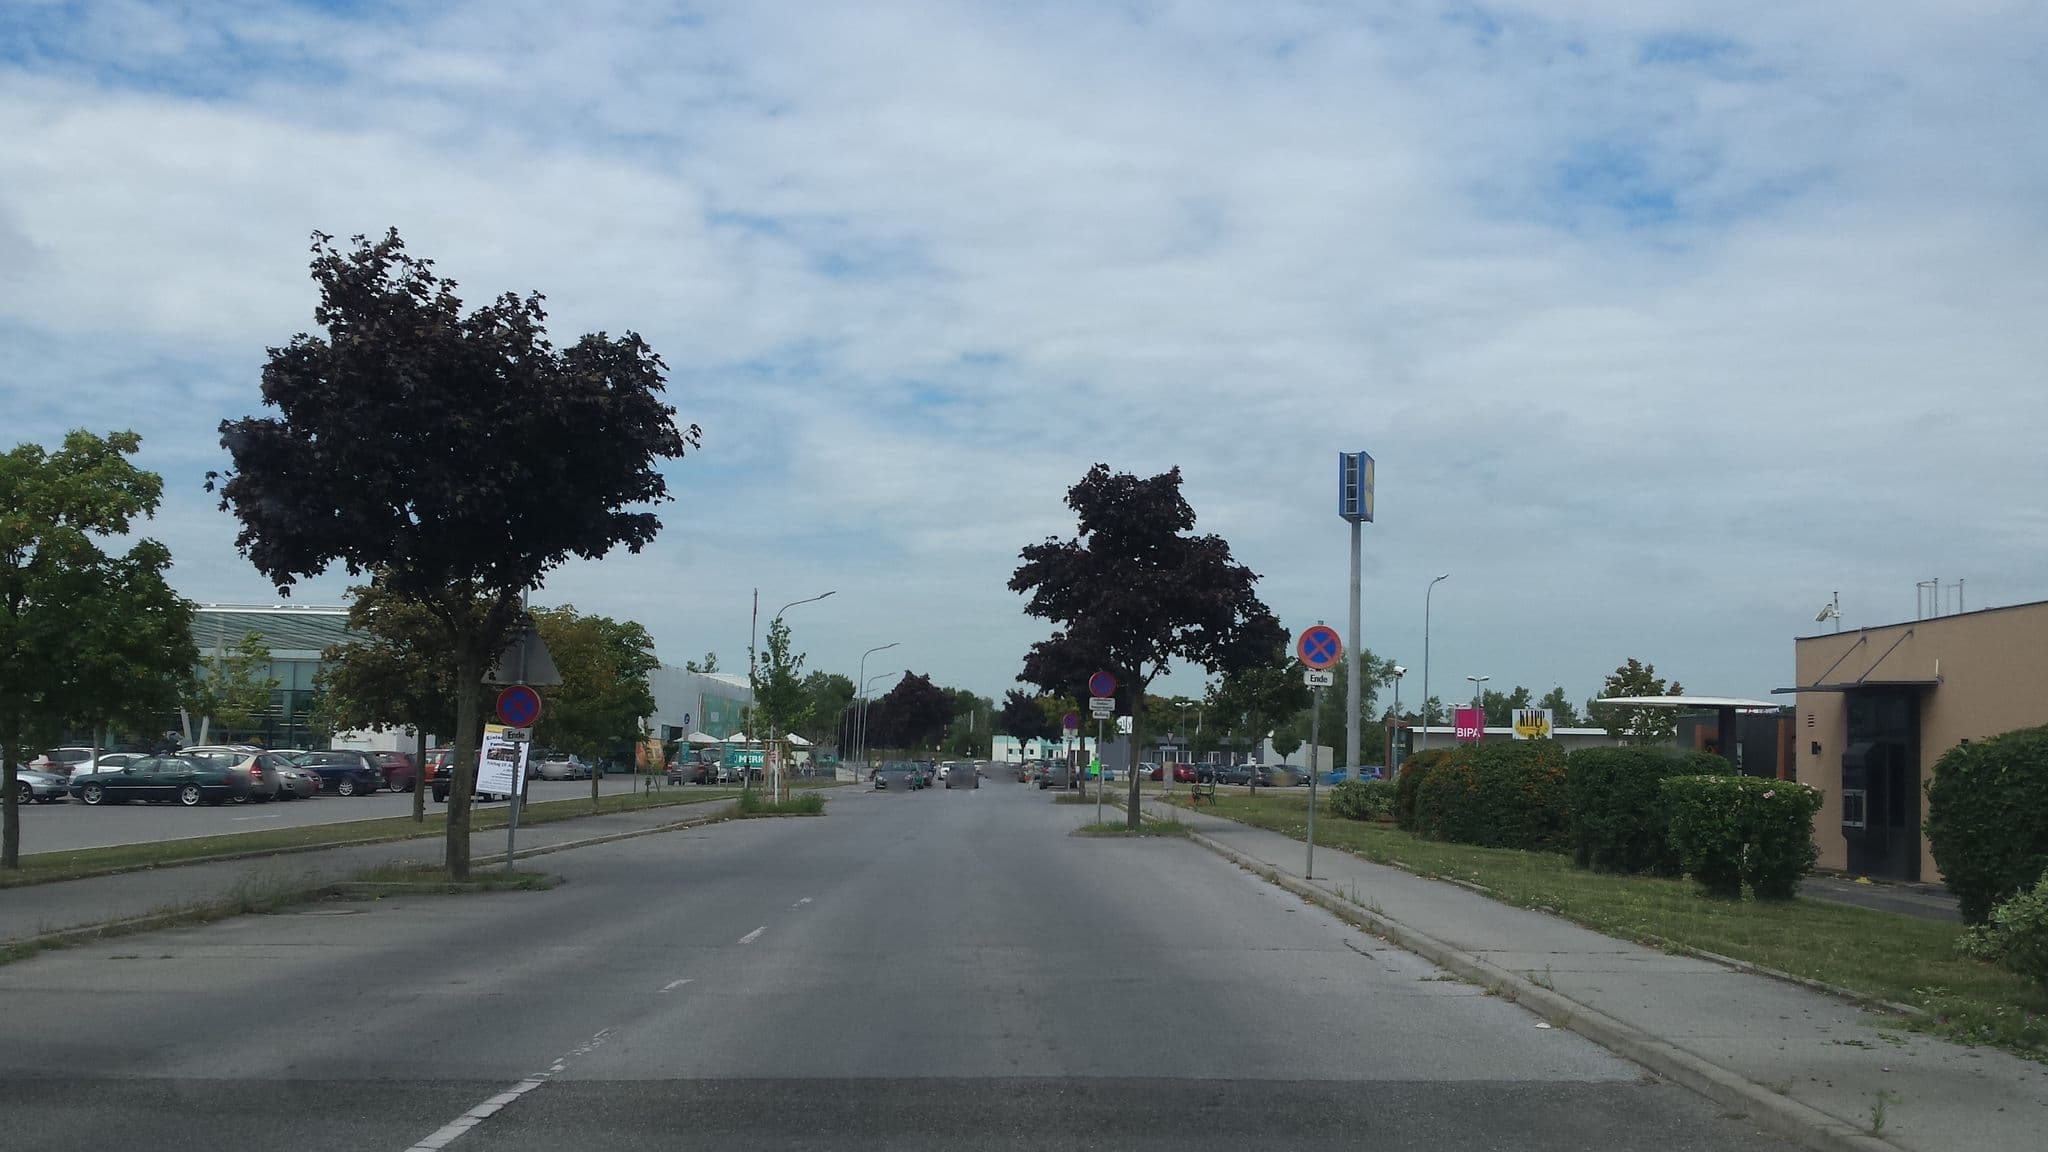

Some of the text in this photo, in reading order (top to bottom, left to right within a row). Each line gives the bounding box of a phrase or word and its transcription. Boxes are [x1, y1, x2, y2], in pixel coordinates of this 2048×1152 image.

[1310, 675, 1328, 683] Ende
[508, 731, 525, 739] Ende
[1457, 728, 1480, 737] BIPA
[738, 755, 764, 763] MERK
